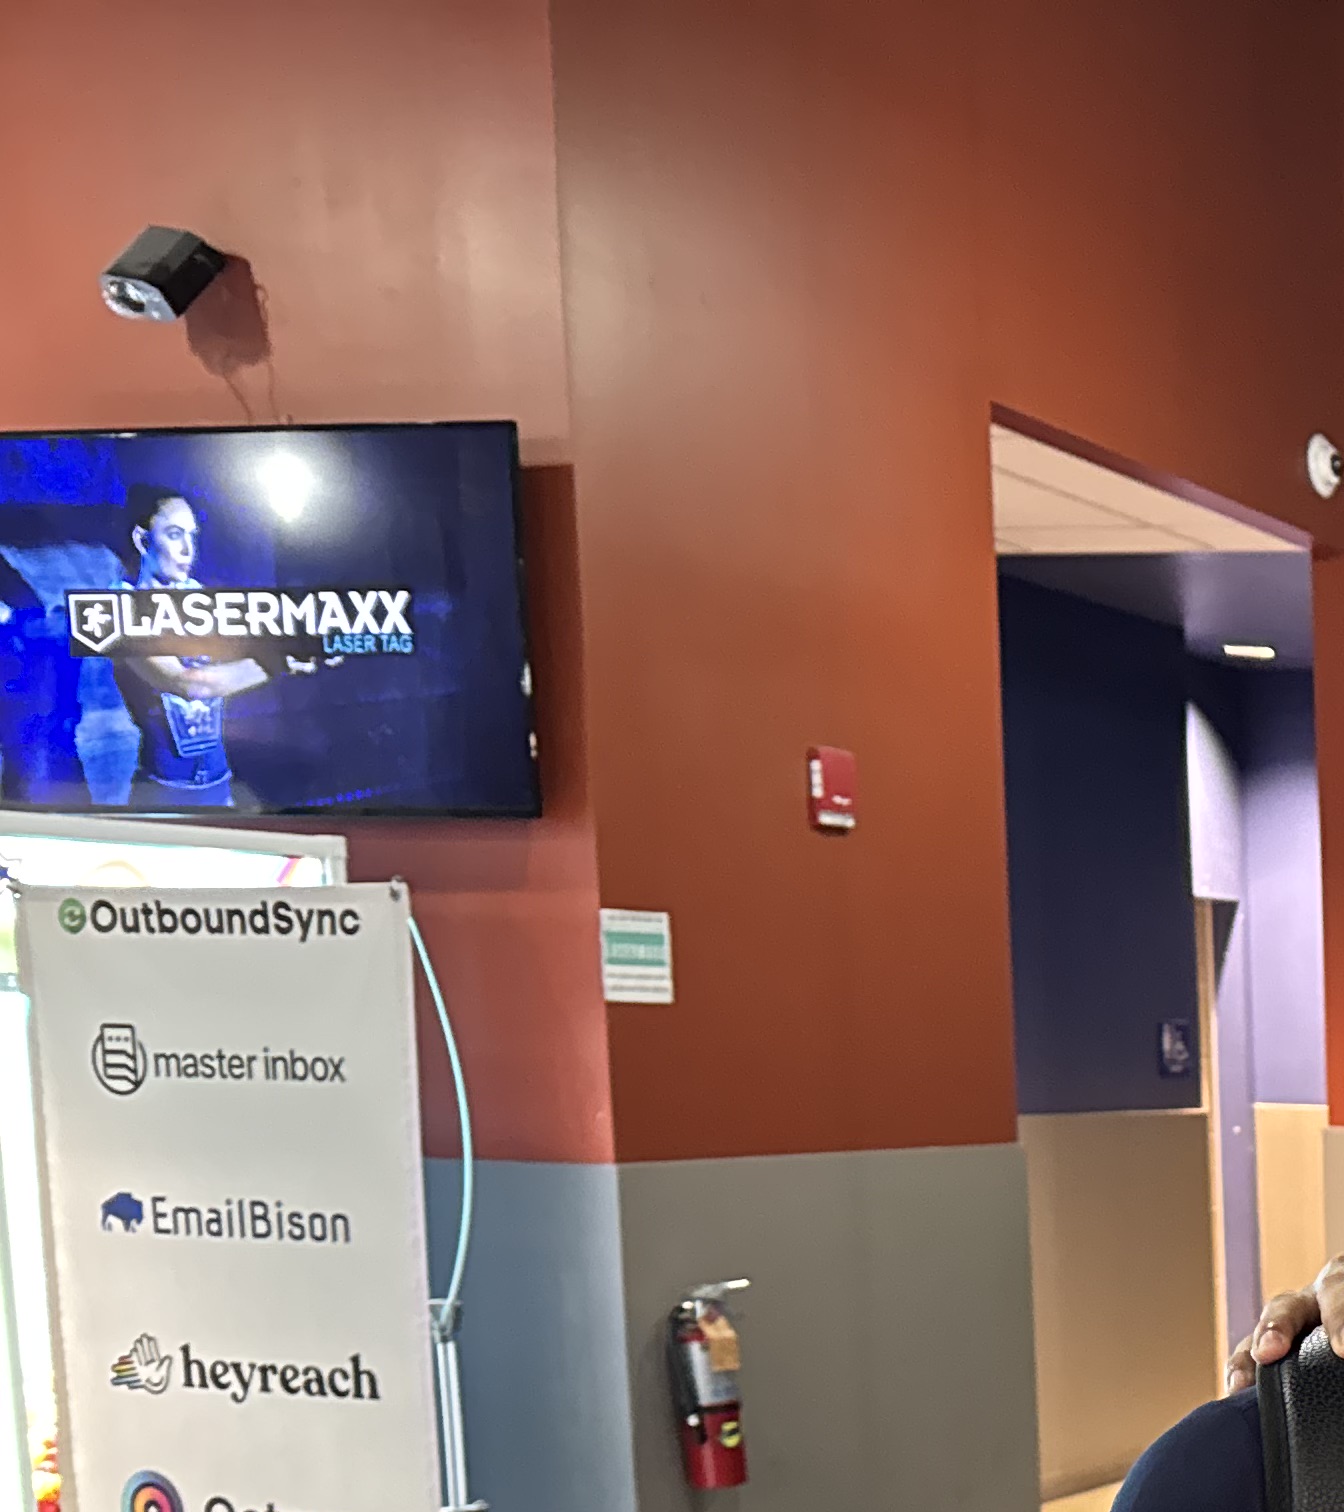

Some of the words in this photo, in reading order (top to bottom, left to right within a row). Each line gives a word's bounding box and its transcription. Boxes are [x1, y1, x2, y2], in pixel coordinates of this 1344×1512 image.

[121, 589, 412, 637] LASERMAXX
[323, 634, 377, 654] LASER
[379, 634, 413, 653] TAG
[90, 899, 361, 943] OutboundSync
[153, 1048, 257, 1081] master
[263, 1046, 347, 1083] inbox
[151, 1196, 352, 1244] EmailBison
[180, 1344, 381, 1404] heyreach
